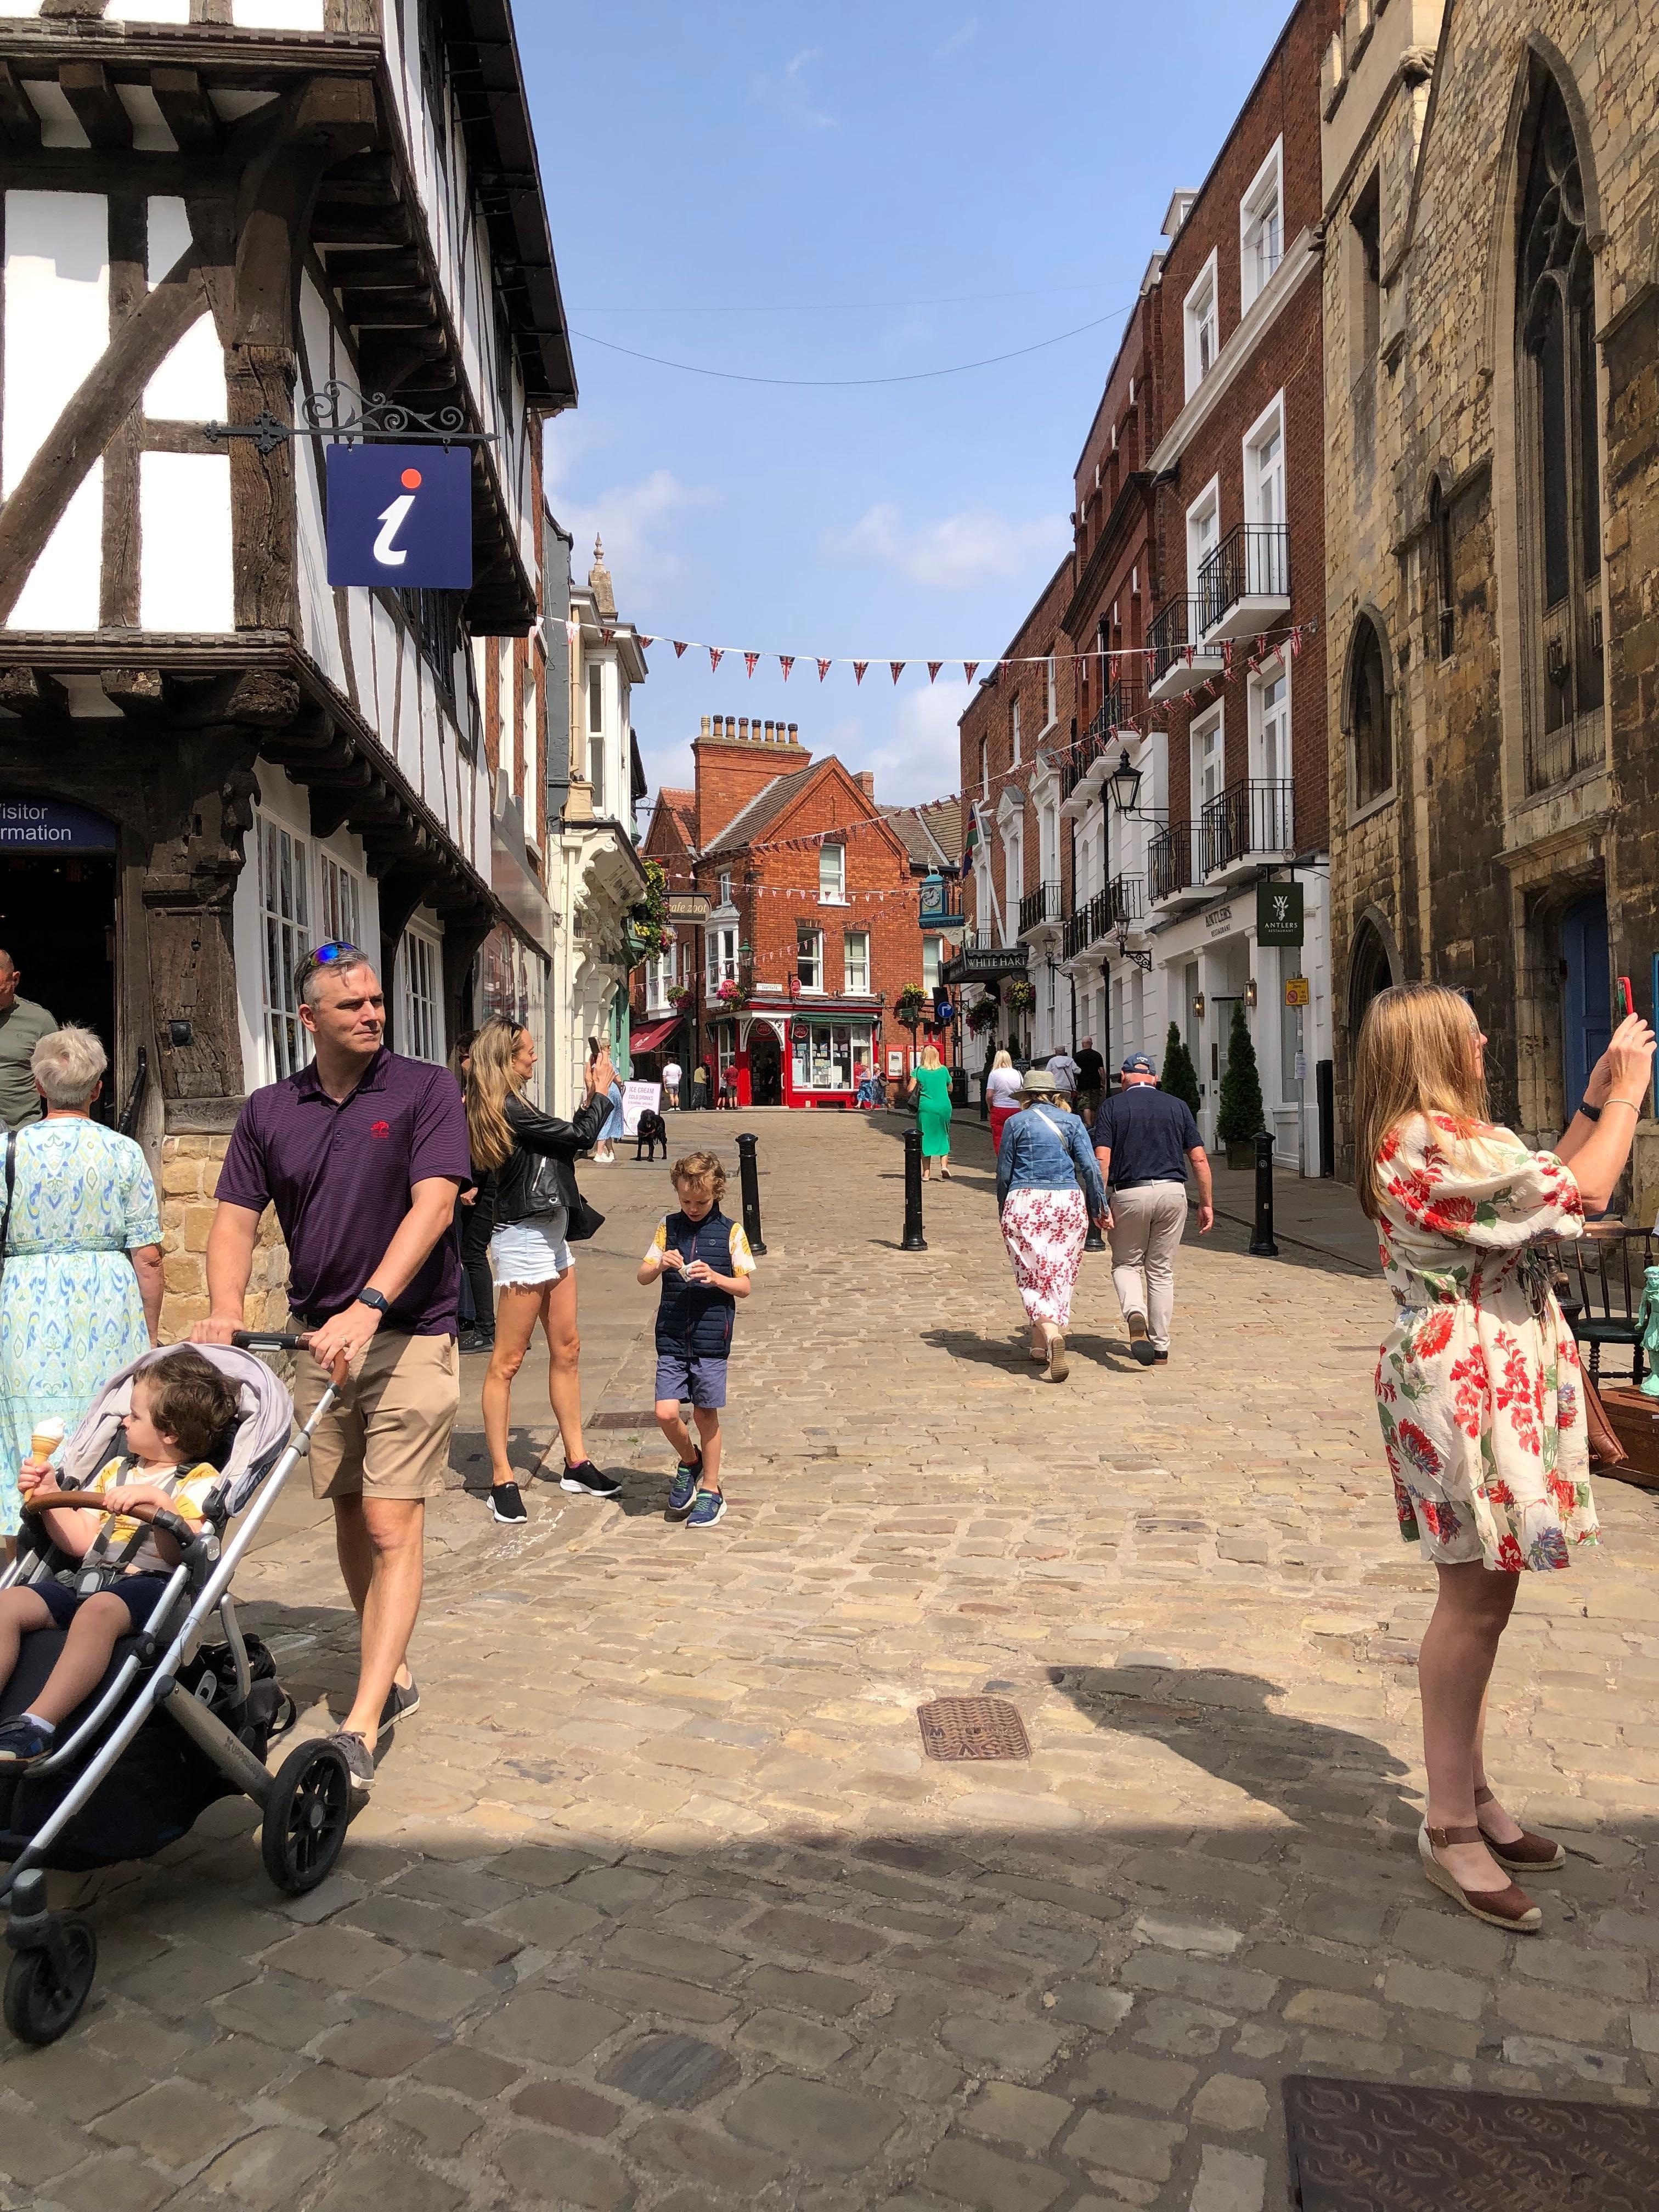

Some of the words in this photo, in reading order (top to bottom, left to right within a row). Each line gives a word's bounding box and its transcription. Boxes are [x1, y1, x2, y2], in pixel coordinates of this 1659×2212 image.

[374, 468, 421, 565] i
[0, 803, 48, 820] isitor
[1, 825, 71, 840] rmation
[687, 904, 707, 912] zoot
[967, 958, 998, 967] WHITE
[1000, 957, 1027, 966] HART
